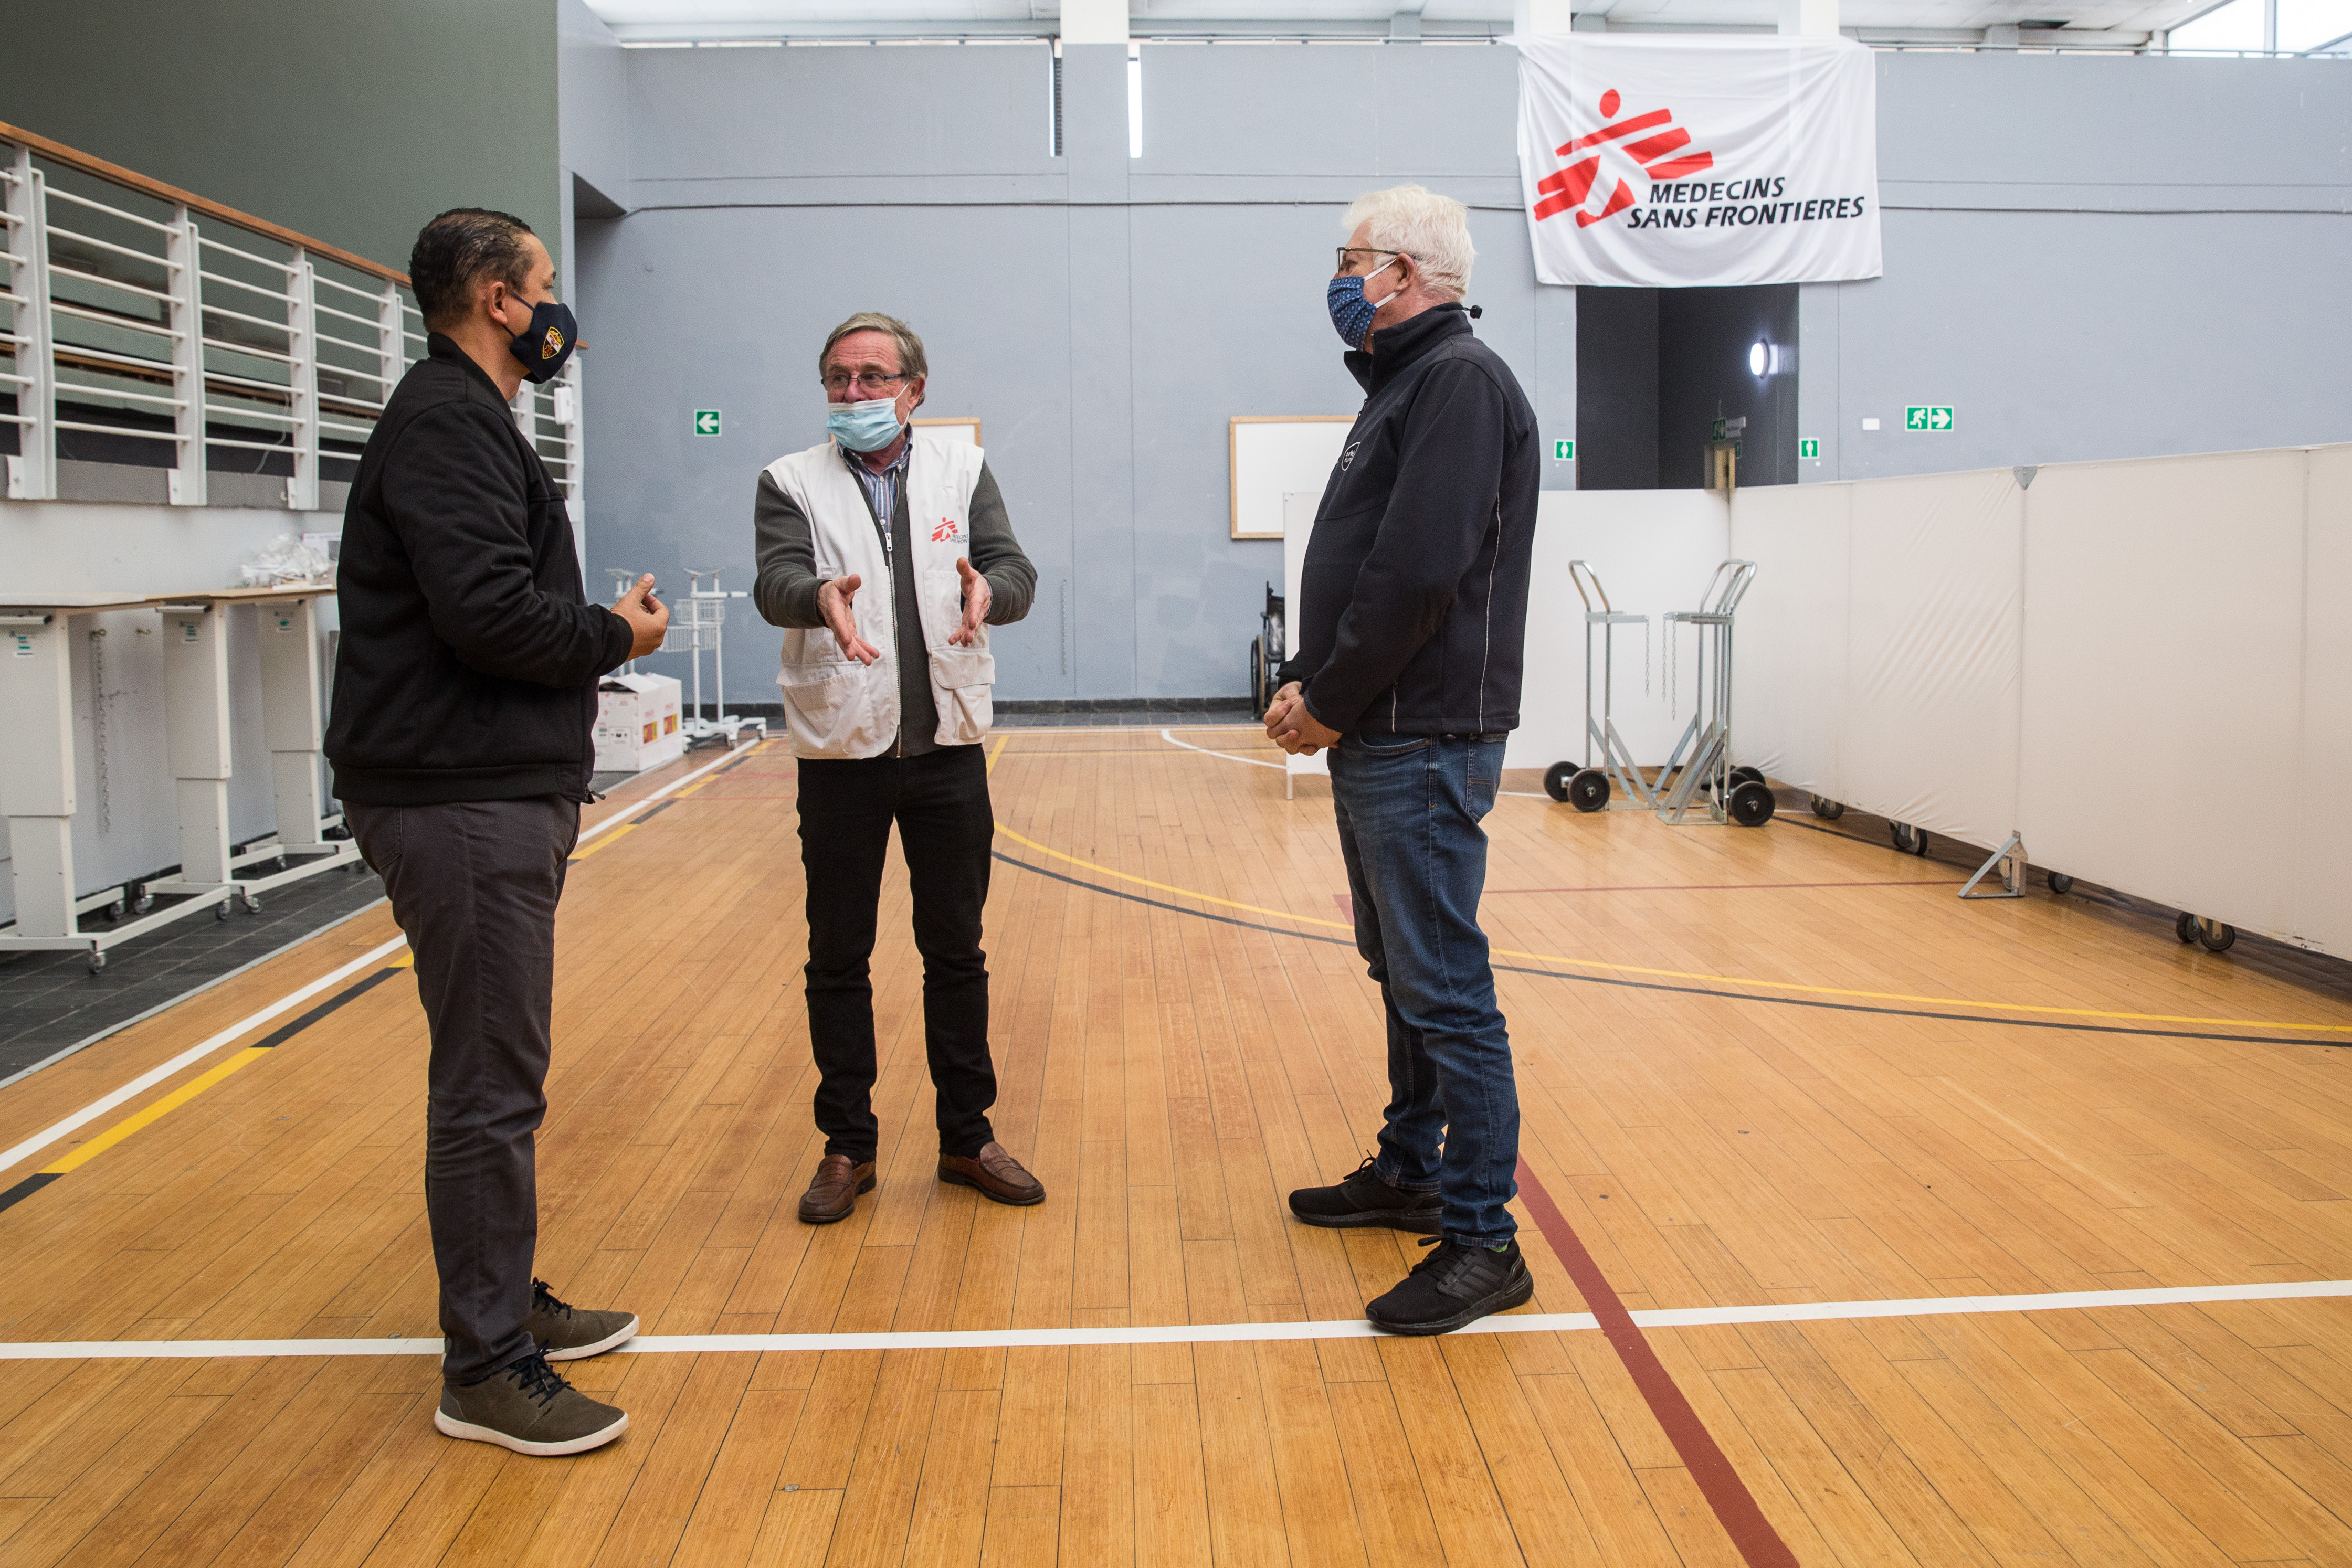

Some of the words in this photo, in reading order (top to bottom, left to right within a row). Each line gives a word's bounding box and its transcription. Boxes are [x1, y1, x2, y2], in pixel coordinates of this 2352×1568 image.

[1650, 177, 1785, 203] MEDECINS
[1627, 208, 1698, 228] SANS
[1705, 196, 1864, 226] FRONTIERES
